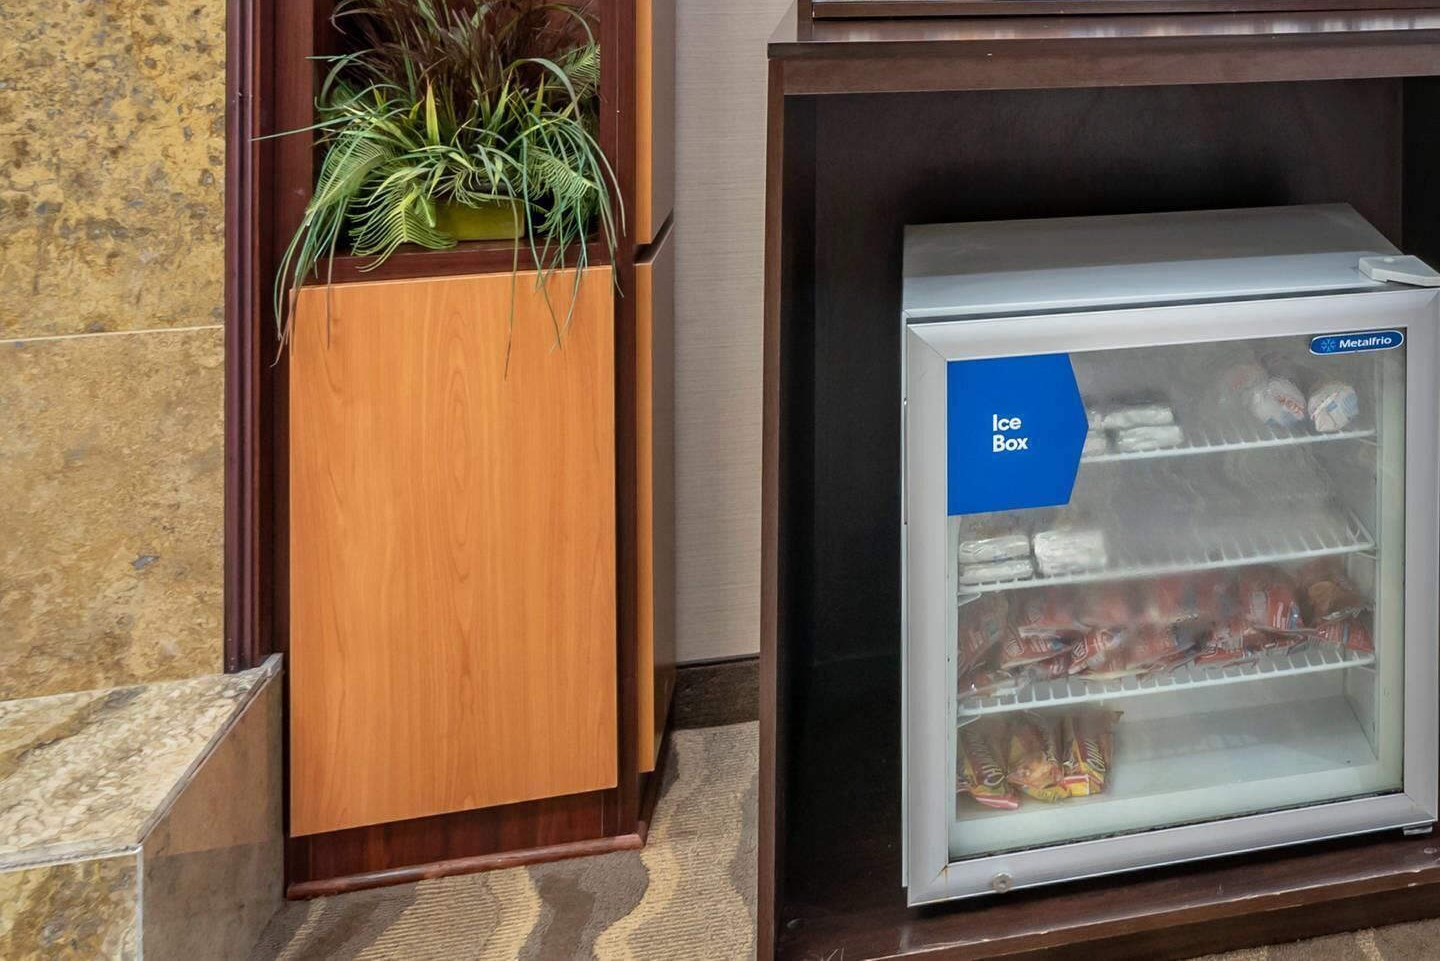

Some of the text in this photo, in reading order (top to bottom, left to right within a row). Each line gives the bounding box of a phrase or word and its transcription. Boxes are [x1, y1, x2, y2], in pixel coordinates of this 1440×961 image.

[1339, 336, 1392, 349] Metalfrio
[992, 414, 1021, 431] Ice
[992, 434, 1028, 452] Box
